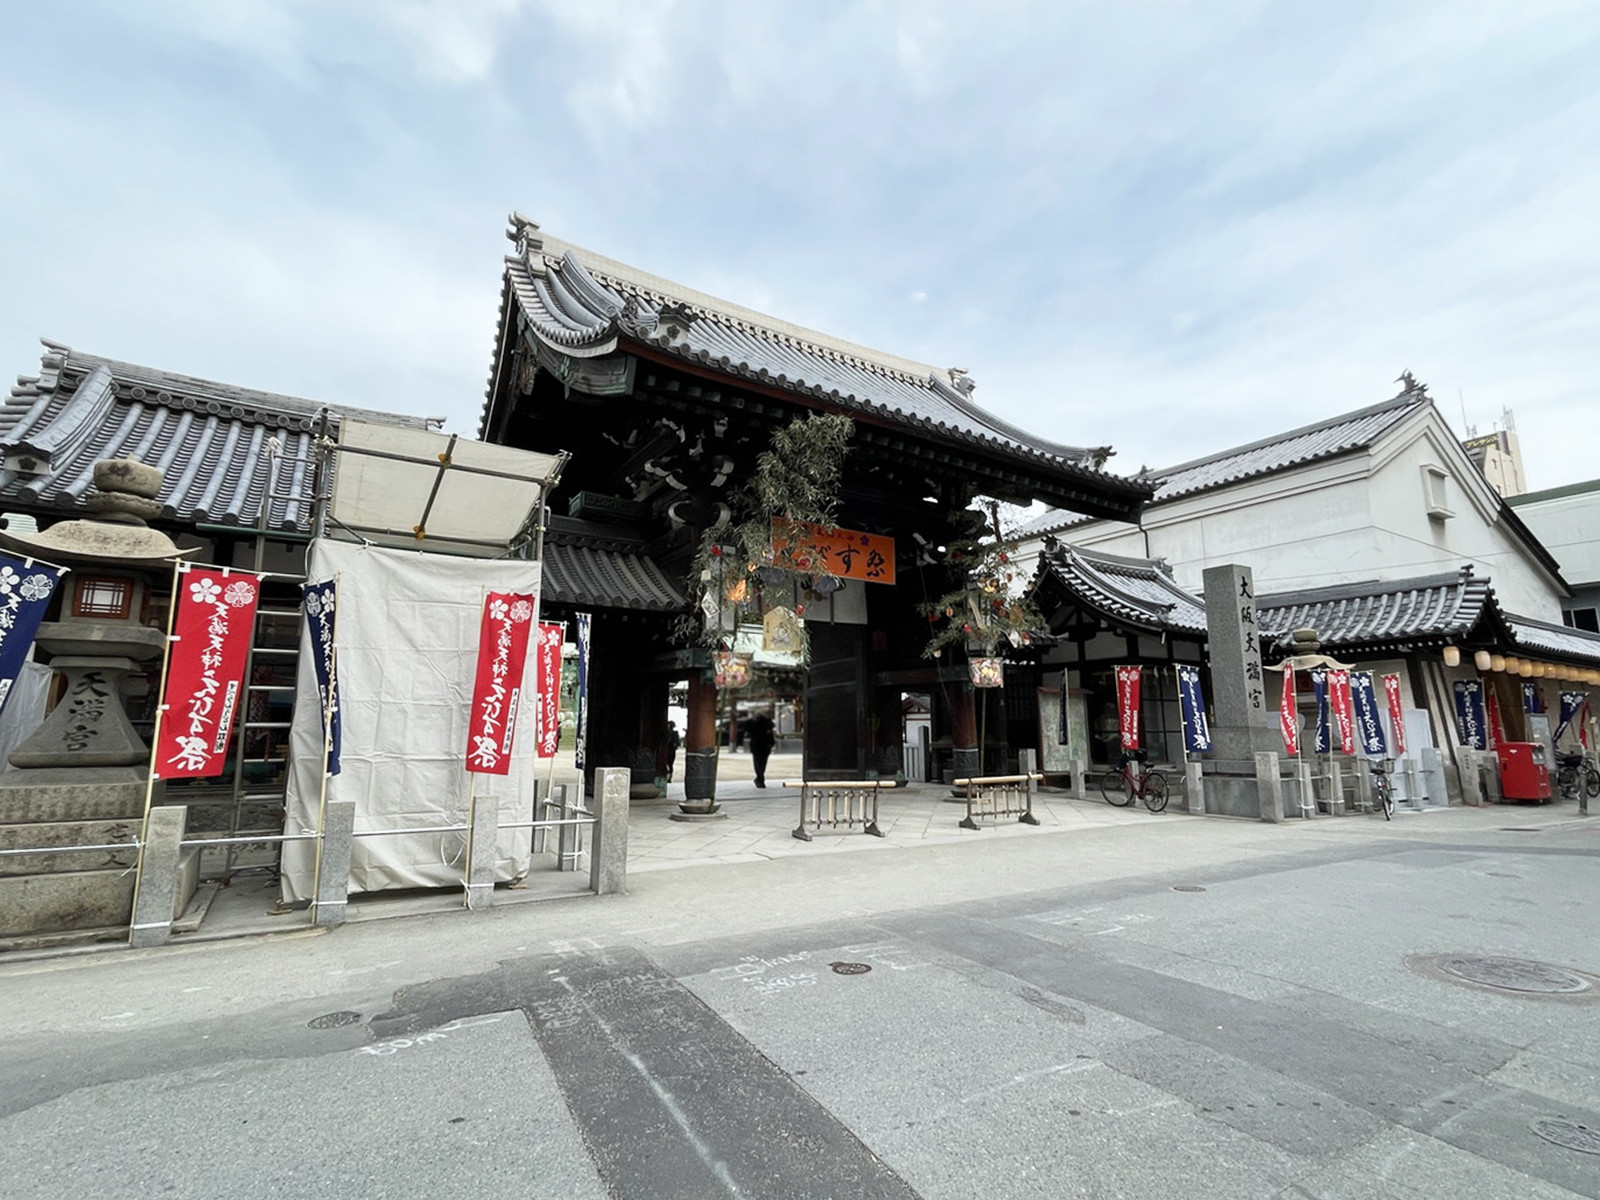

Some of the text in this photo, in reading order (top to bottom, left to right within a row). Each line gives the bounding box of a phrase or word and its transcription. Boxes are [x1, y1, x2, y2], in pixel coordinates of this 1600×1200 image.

[1240, 576, 1262, 709] 大阪天満宮
